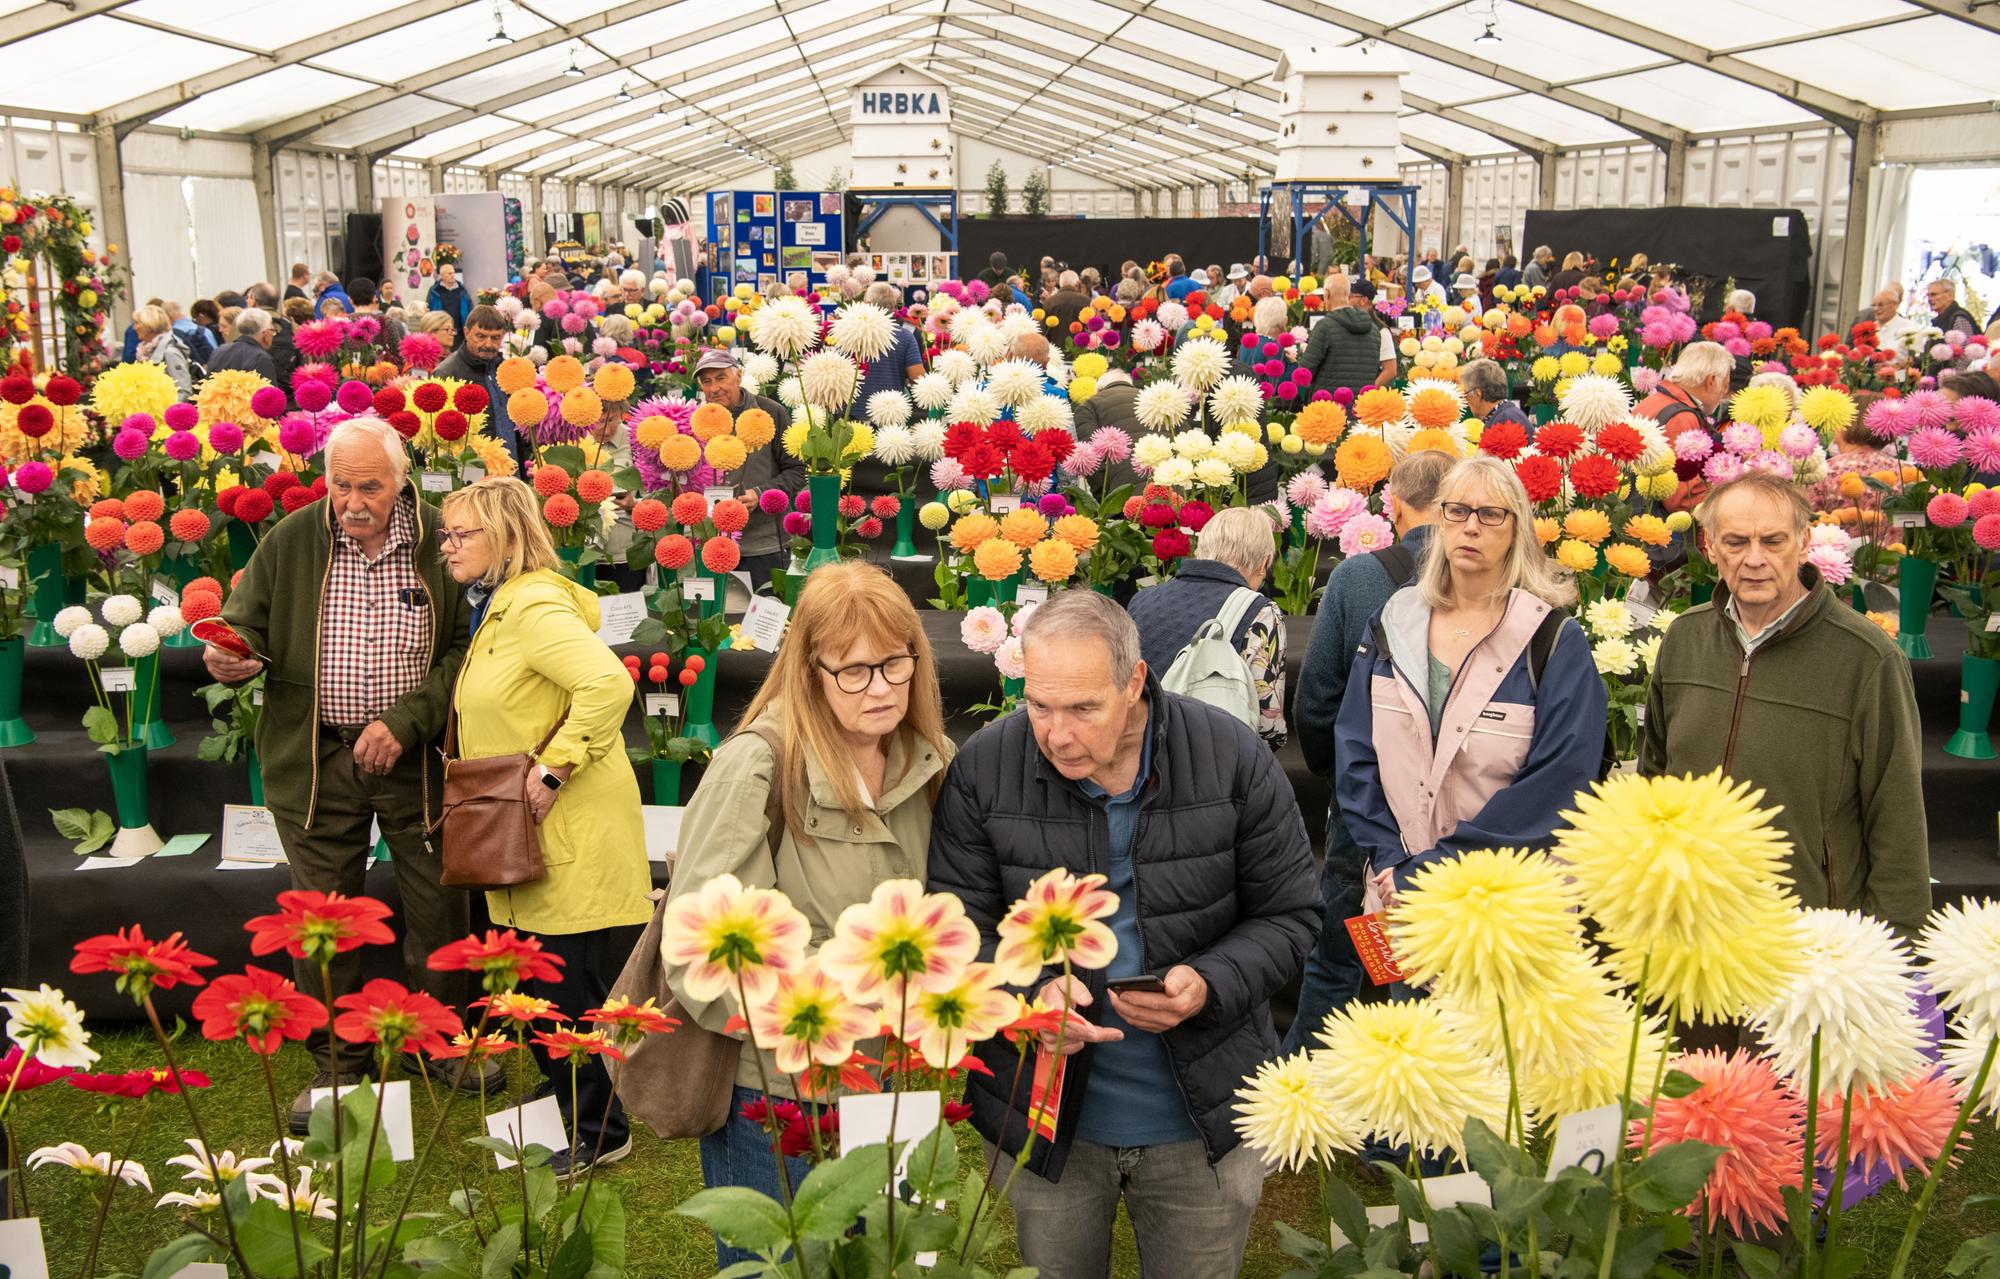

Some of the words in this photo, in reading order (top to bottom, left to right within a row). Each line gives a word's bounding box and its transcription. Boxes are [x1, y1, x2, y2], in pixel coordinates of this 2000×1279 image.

[863, 92, 941, 114] HRBKA
[1357, 922, 1372, 945] SHOW
[1351, 922, 1382, 980] HARROGATE
[1369, 948, 1388, 979] FLOWER
